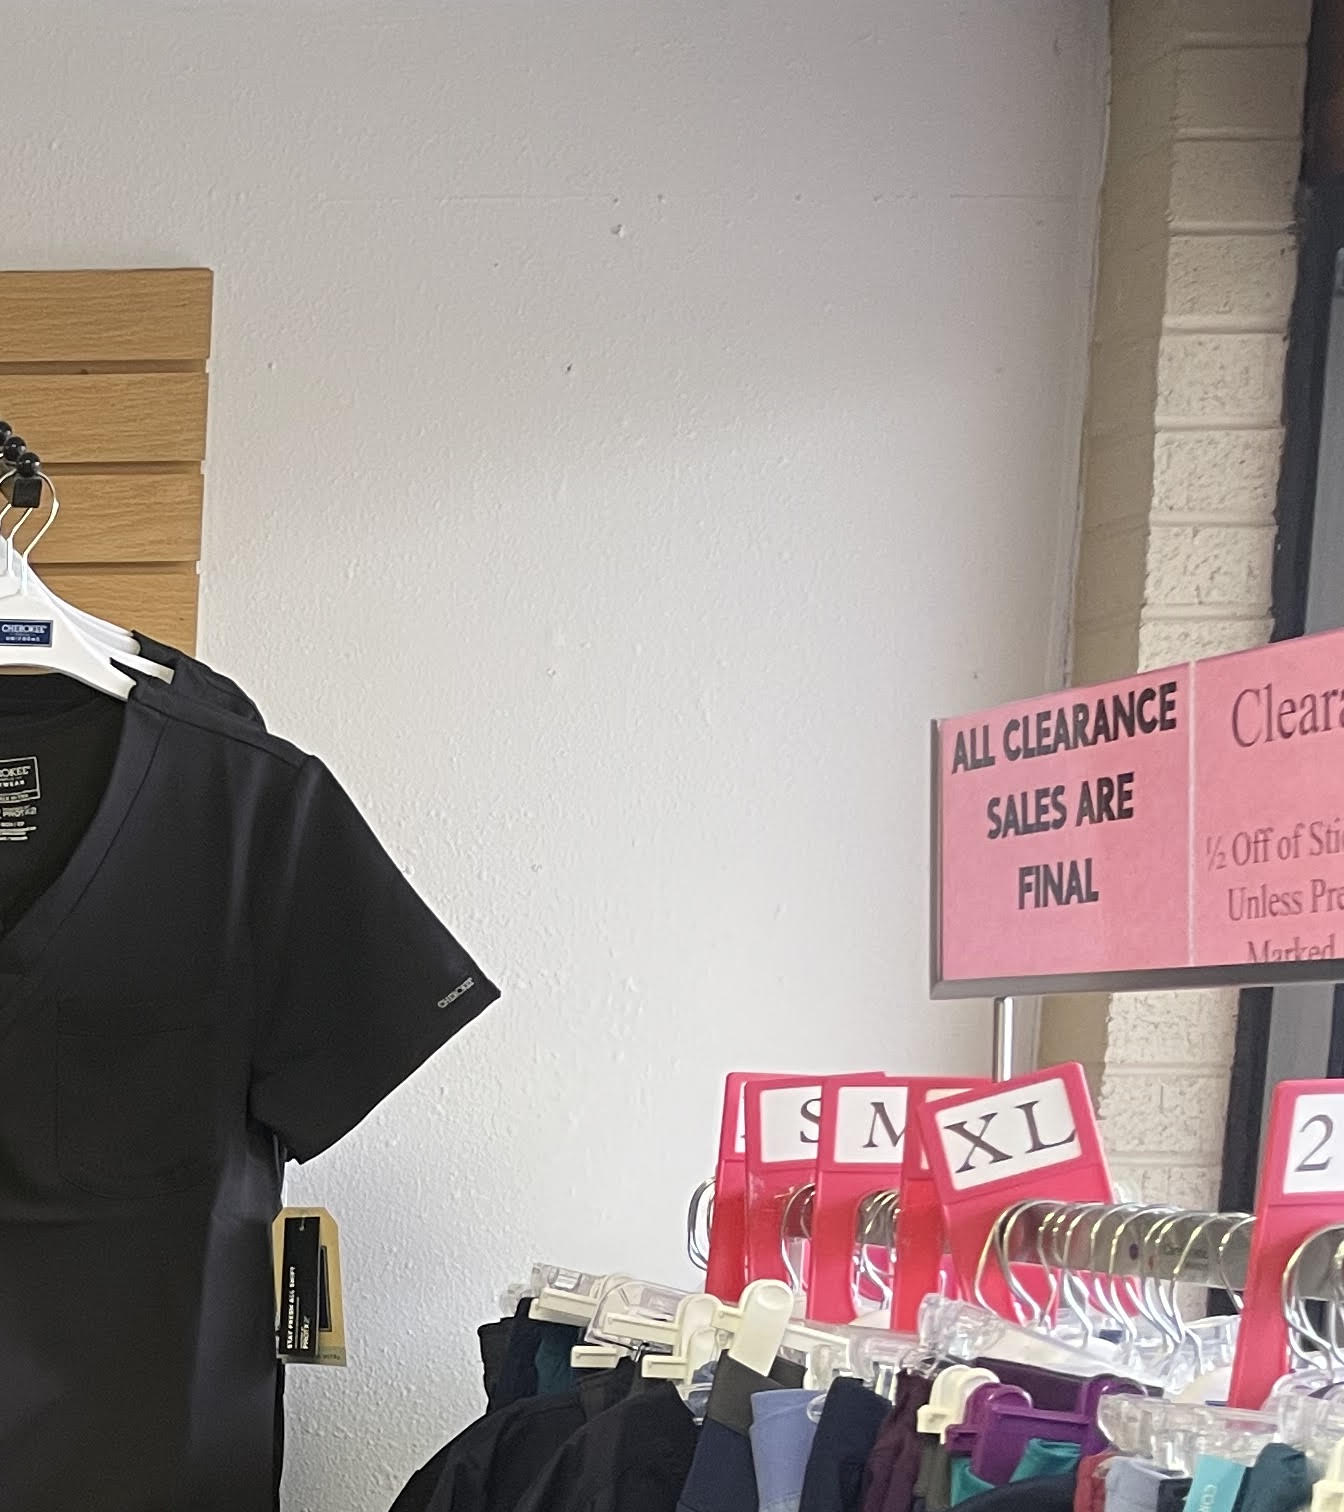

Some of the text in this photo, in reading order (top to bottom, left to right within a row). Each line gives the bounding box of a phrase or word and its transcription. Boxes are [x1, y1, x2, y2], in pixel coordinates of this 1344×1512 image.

[951, 681, 1177, 775] ALL CLEARANCE
[986, 771, 1135, 840] SALES ARE
[1232, 826, 1274, 867] Off
[1277, 822, 1305, 860] of
[1309, 817, 1344, 857] Sti
[1018, 857, 1100, 910] FINAL
[1228, 883, 1303, 921] Unless
[800, 1097, 822, 1144] S
[943, 1100, 1077, 1174] XL
[1294, 1114, 1334, 1172] 2
